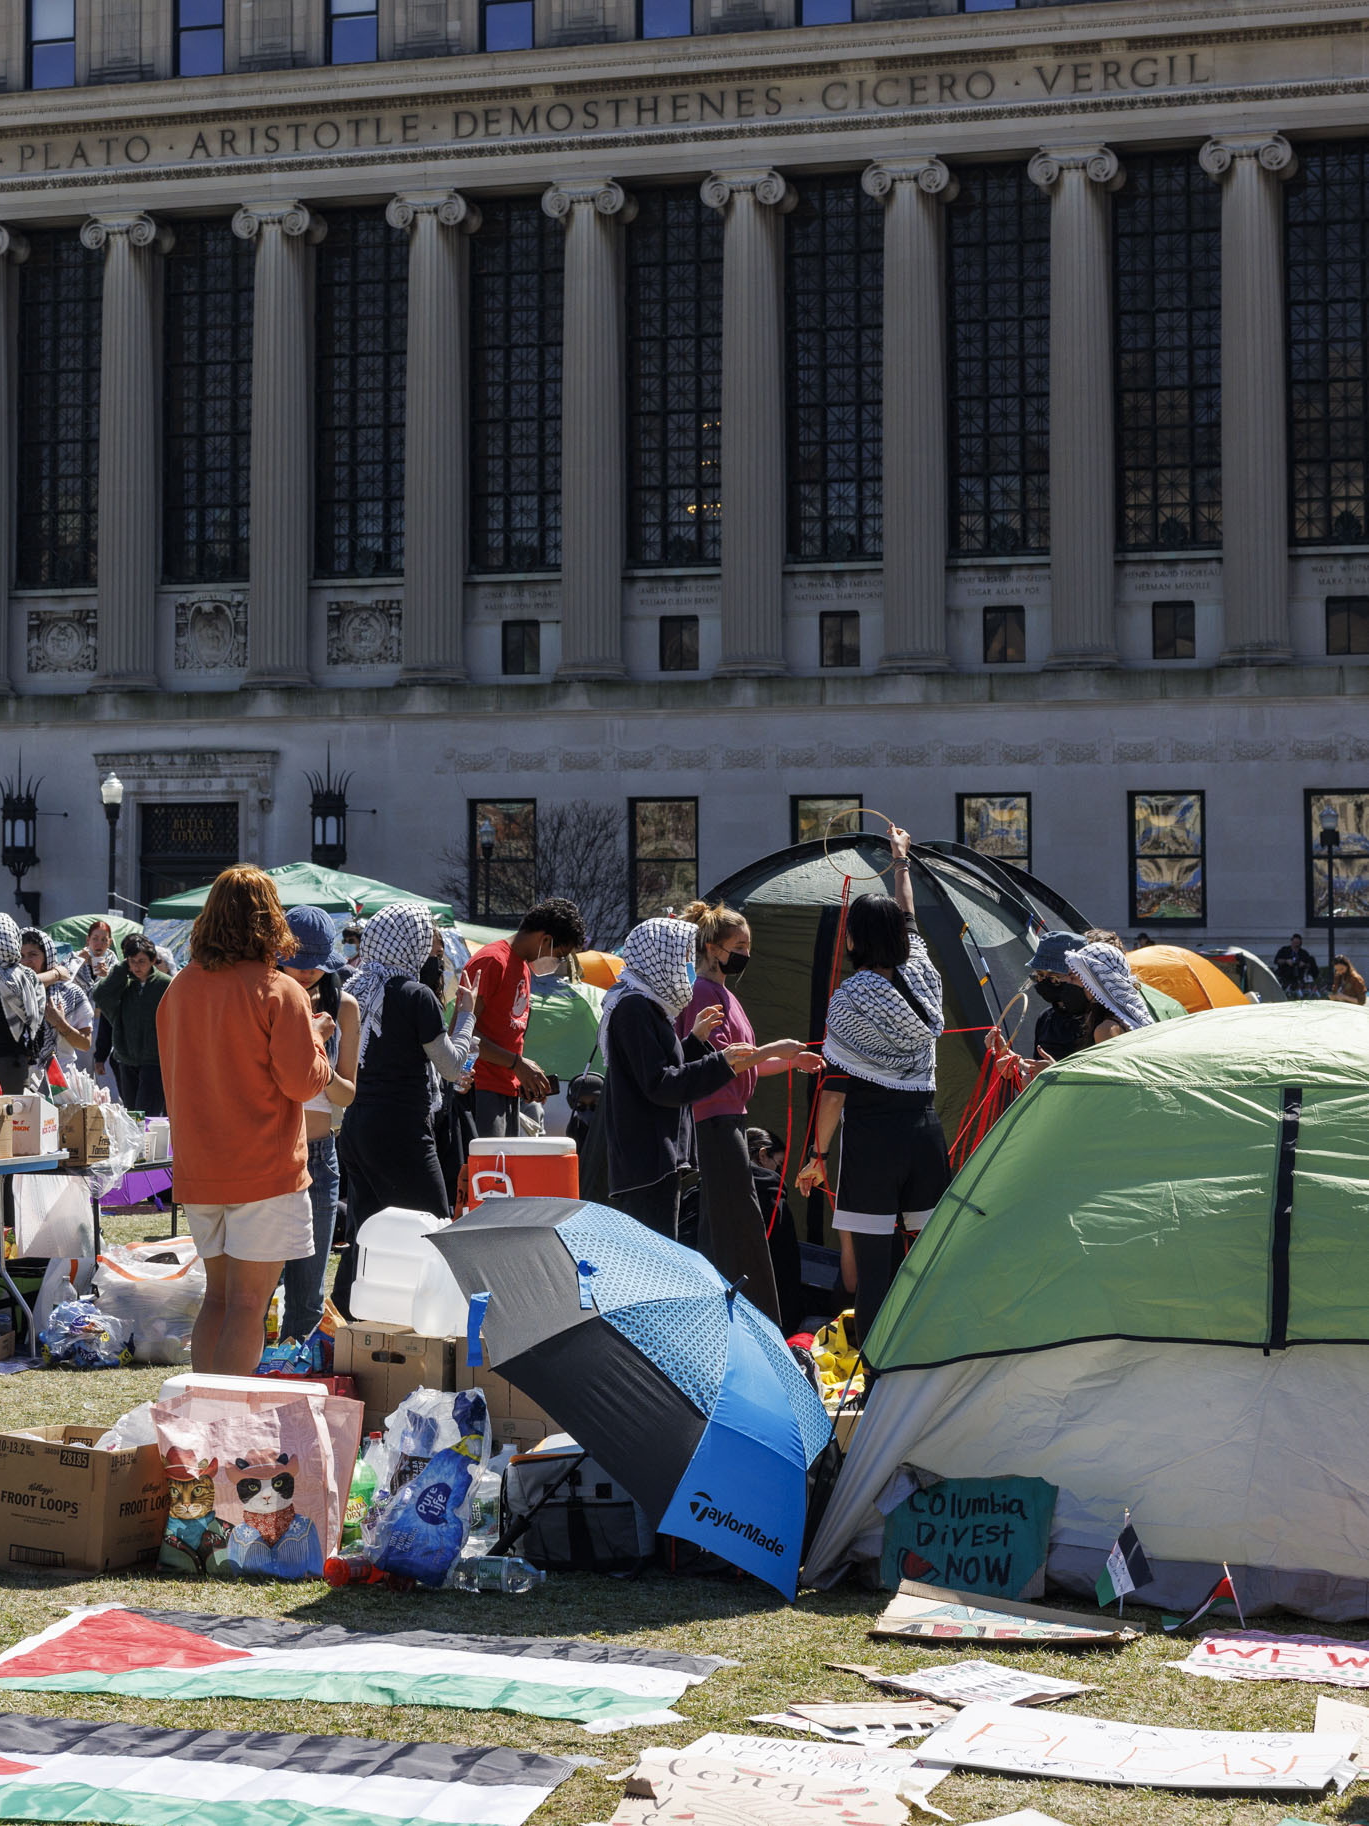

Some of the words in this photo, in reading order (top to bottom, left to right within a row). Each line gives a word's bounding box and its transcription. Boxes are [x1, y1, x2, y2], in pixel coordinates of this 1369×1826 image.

[18, 134, 151, 173] PLATO
[187, 113, 421, 160] ARISTOTLE
[453, 86, 783, 141] DEMOSTHENES
[821, 69, 996, 113] CICERO
[1034, 53, 1212, 95] VERGIL
[171, 830, 215, 841] LIBRARY
[173, 819, 214, 829] BUTLER
[61, 1451, 89, 1467] 28185
[0, 1490, 37, 1508] FROOT
[40, 1496, 79, 1515] LOOPS
[119, 1498, 148, 1518] FROOT
[417, 1486, 438, 1515] Pure
[429, 1493, 447, 1517] Life
[346, 1510, 362, 1521] DRY
[689, 1491, 785, 1557] TaylorMade
[395, 1531, 409, 1551] PURA
[402, 1527, 420, 1553] CALIDAD
[944, 1552, 1013, 1587] NOW
[1206, 1643, 1315, 1666] WE
[717, 1735, 822, 1755] YOUNG
[964, 1722, 1342, 1776] PLEASE
